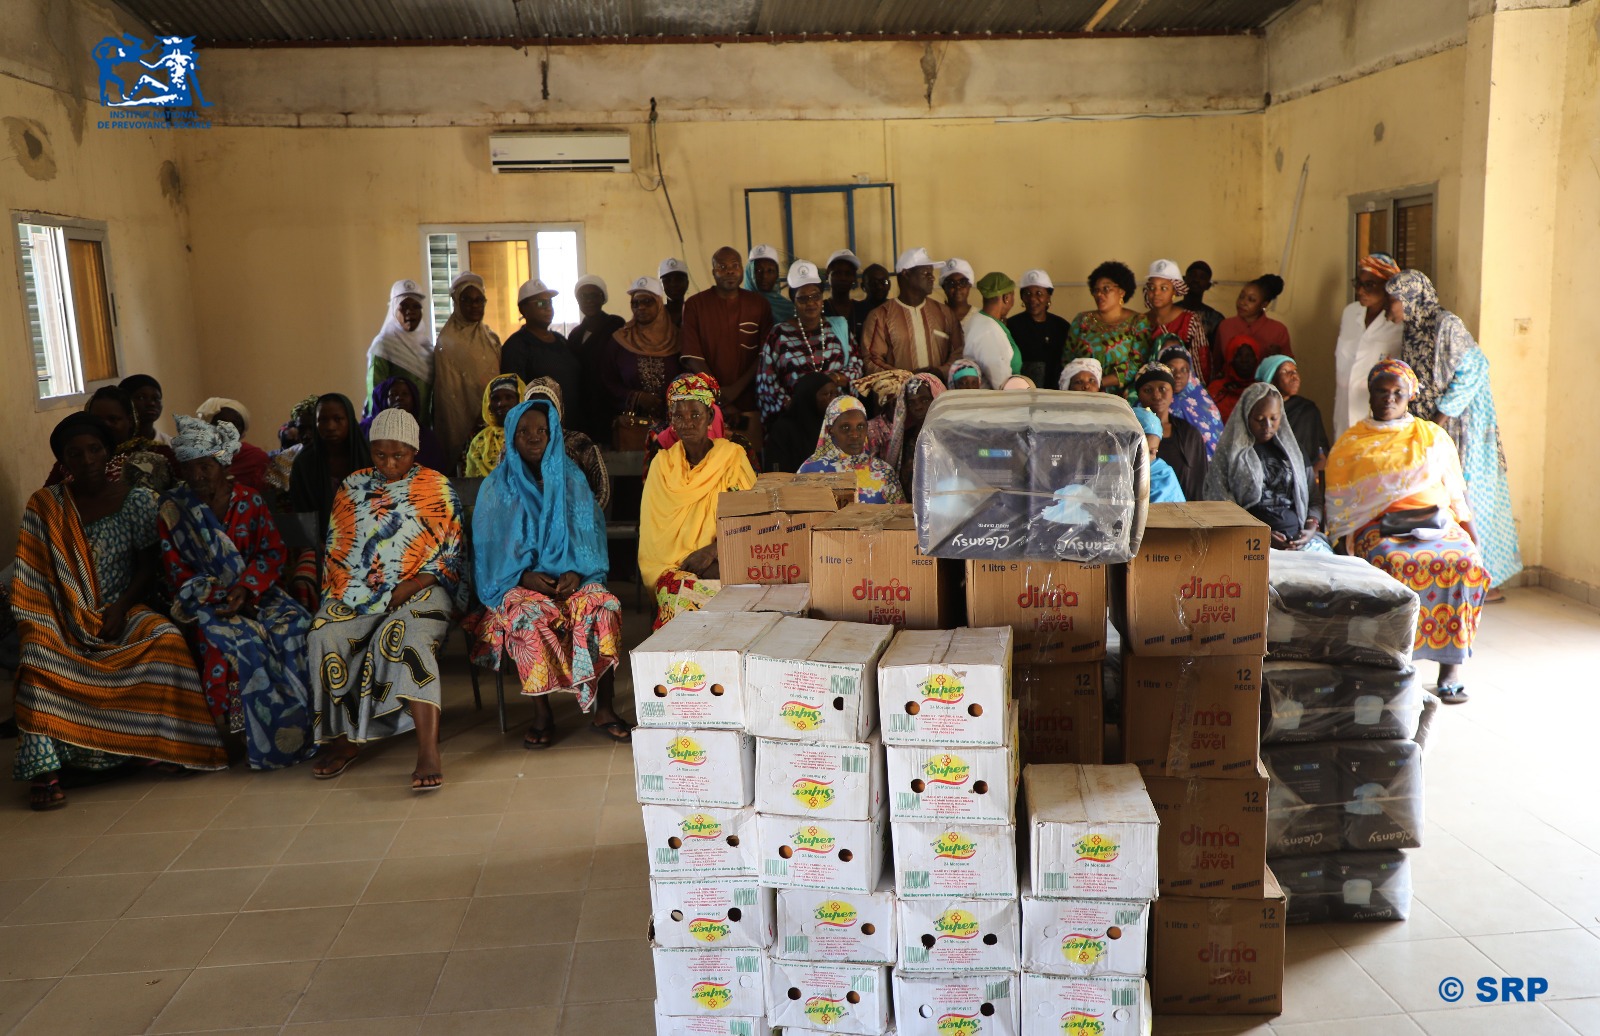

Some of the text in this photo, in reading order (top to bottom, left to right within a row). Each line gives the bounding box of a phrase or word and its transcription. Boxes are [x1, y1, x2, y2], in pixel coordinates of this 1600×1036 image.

[952, 534, 1010, 549] Cleansy
[1246, 538, 1260, 550] 12
[750, 543, 789, 558] Javel
[825, 555, 842, 564] litre
[1152, 554, 1169, 562] litre
[989, 563, 1006, 572] litre
[748, 564, 800, 584] dima
[852, 578, 910, 601] dima
[1180, 576, 1240, 599] dima
[1017, 585, 1078, 608] dima
[1191, 608, 1236, 623] Javel
[666, 674, 706, 685] Super
[1075, 674, 1090, 686] 12
[1236, 669, 1251, 680] 12
[1144, 680, 1160, 688] litre
[921, 684, 964, 697] Super
[779, 708, 822, 721] Super
[668, 748, 706, 760] Super
[926, 765, 970, 777] Super
[792, 786, 834, 798] Super
[1244, 792, 1259, 802] 12
[682, 822, 721, 832] Super
[794, 835, 835, 846] Super
[1180, 824, 1240, 847] dima
[1368, 830, 1413, 842] Cleansy
[934, 842, 977, 854] Super
[1076, 844, 1120, 855] Super
[1192, 856, 1234, 870] Javel
[815, 909, 856, 920] Super
[1261, 908, 1275, 919] 12
[690, 924, 730, 936] Super
[934, 921, 978, 933] Super
[1063, 940, 1106, 951] Super
[1198, 942, 1256, 963] dima
[692, 988, 731, 998] Super
[804, 1004, 845, 1015] Super
[939, 1018, 980, 1029] Super
[1061, 1019, 1104, 1029] Super
